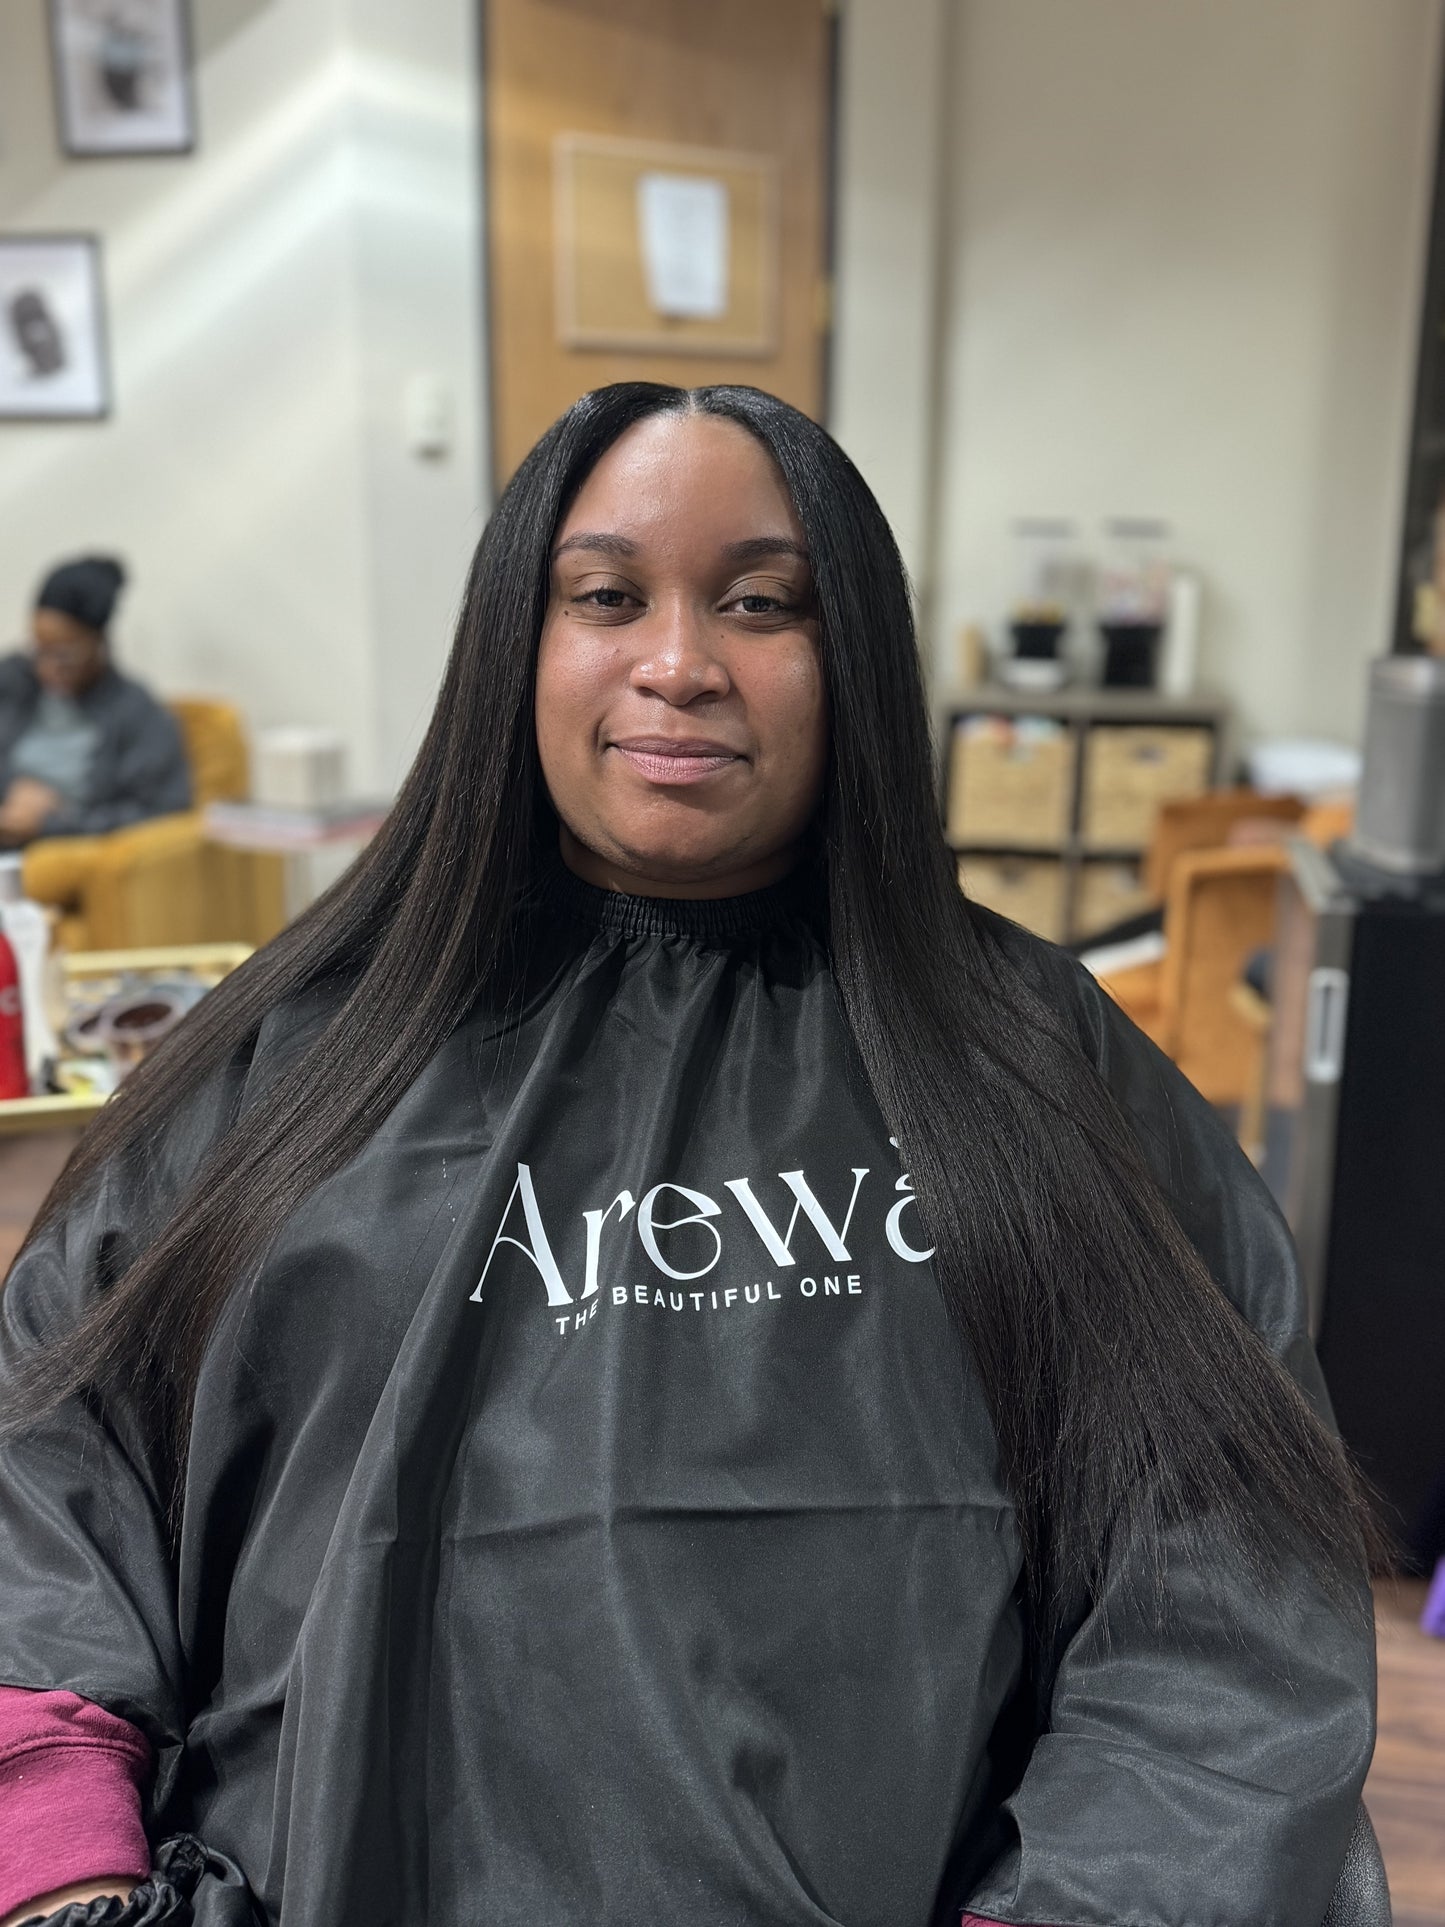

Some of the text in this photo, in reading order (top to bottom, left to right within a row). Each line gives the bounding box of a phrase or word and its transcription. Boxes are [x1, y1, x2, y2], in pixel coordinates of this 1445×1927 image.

[555, 1274, 863, 1335] THE BEAUTIFUL ONE
